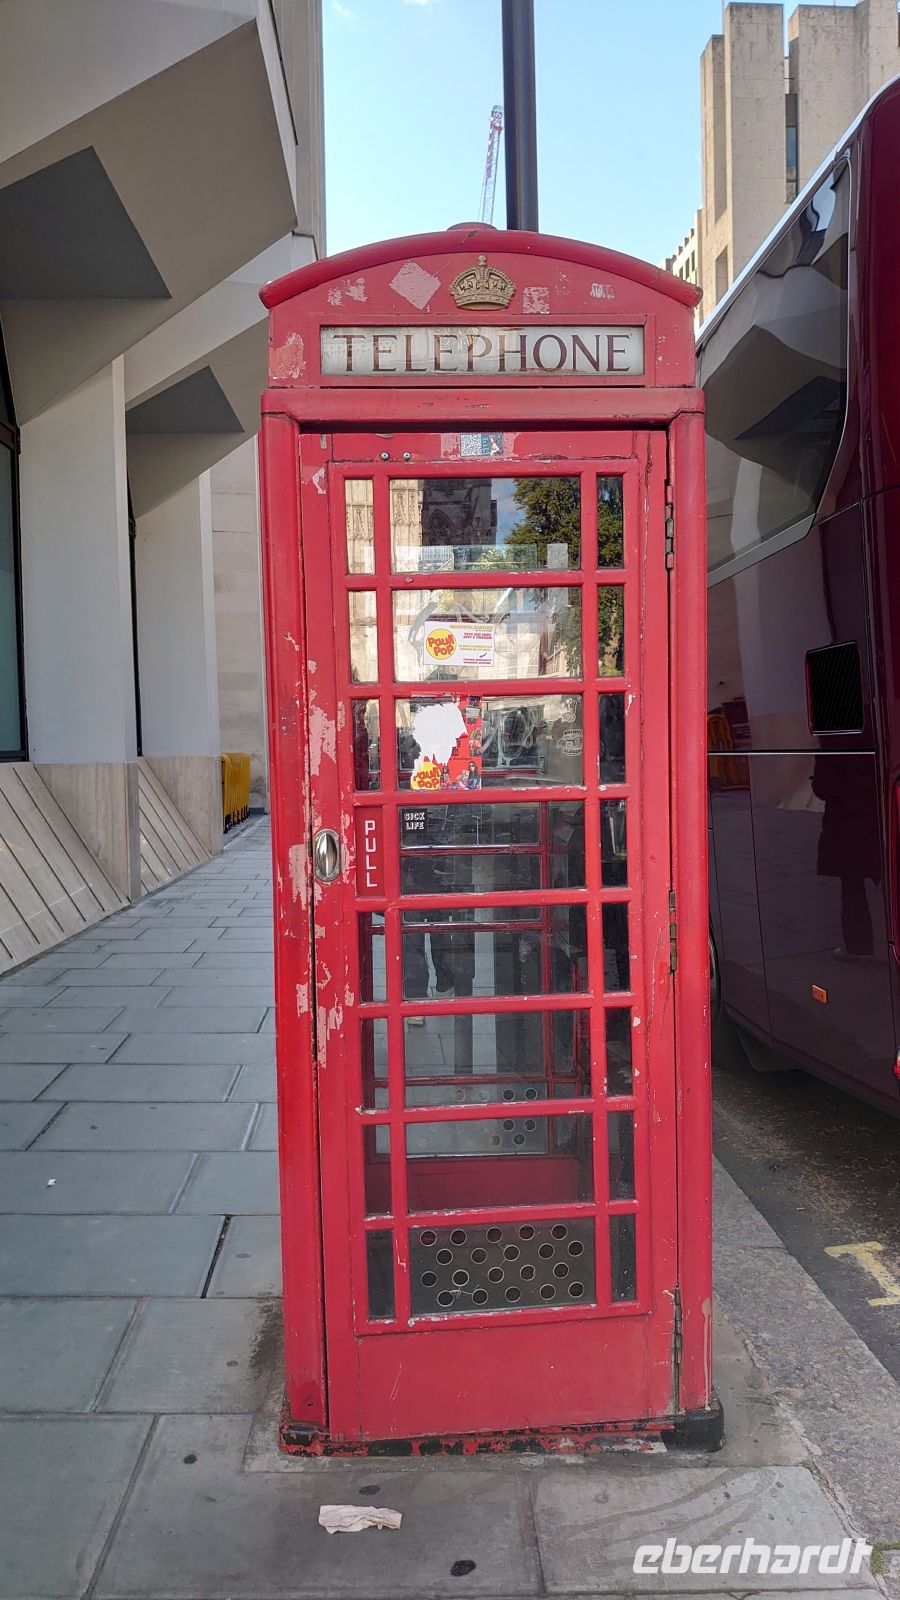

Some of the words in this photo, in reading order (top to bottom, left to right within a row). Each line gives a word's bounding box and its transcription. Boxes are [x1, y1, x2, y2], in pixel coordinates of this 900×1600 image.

[332, 333, 631, 372] TELEPHONE
[403, 812, 426, 821] SICK
[405, 822, 425, 831] LIFE
[364, 819, 378, 888] PULL
